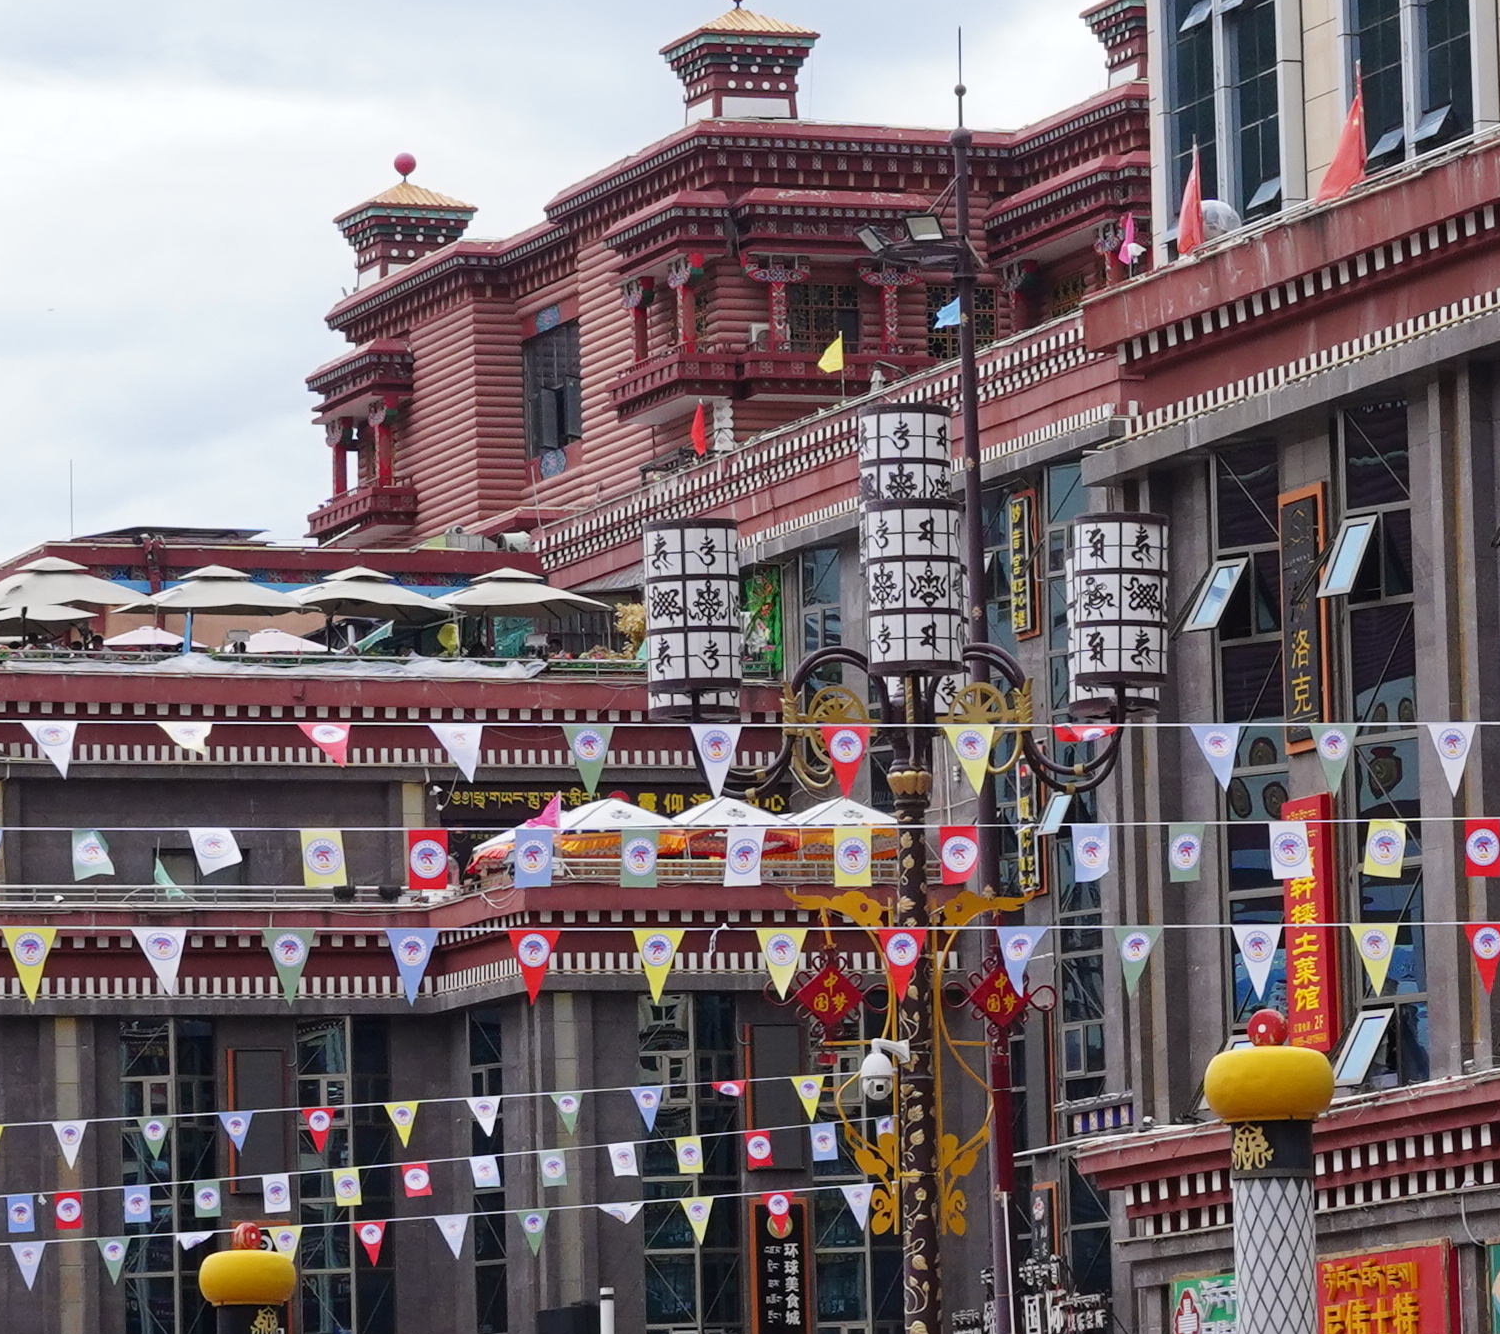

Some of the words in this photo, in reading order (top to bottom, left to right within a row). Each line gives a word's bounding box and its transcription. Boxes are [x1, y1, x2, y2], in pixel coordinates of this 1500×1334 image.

[1289, 846, 1322, 1013] 轩楼土菜馆
[1313, 1014, 1325, 1031] 2F
[783, 1242, 801, 1326] 环球美食城
